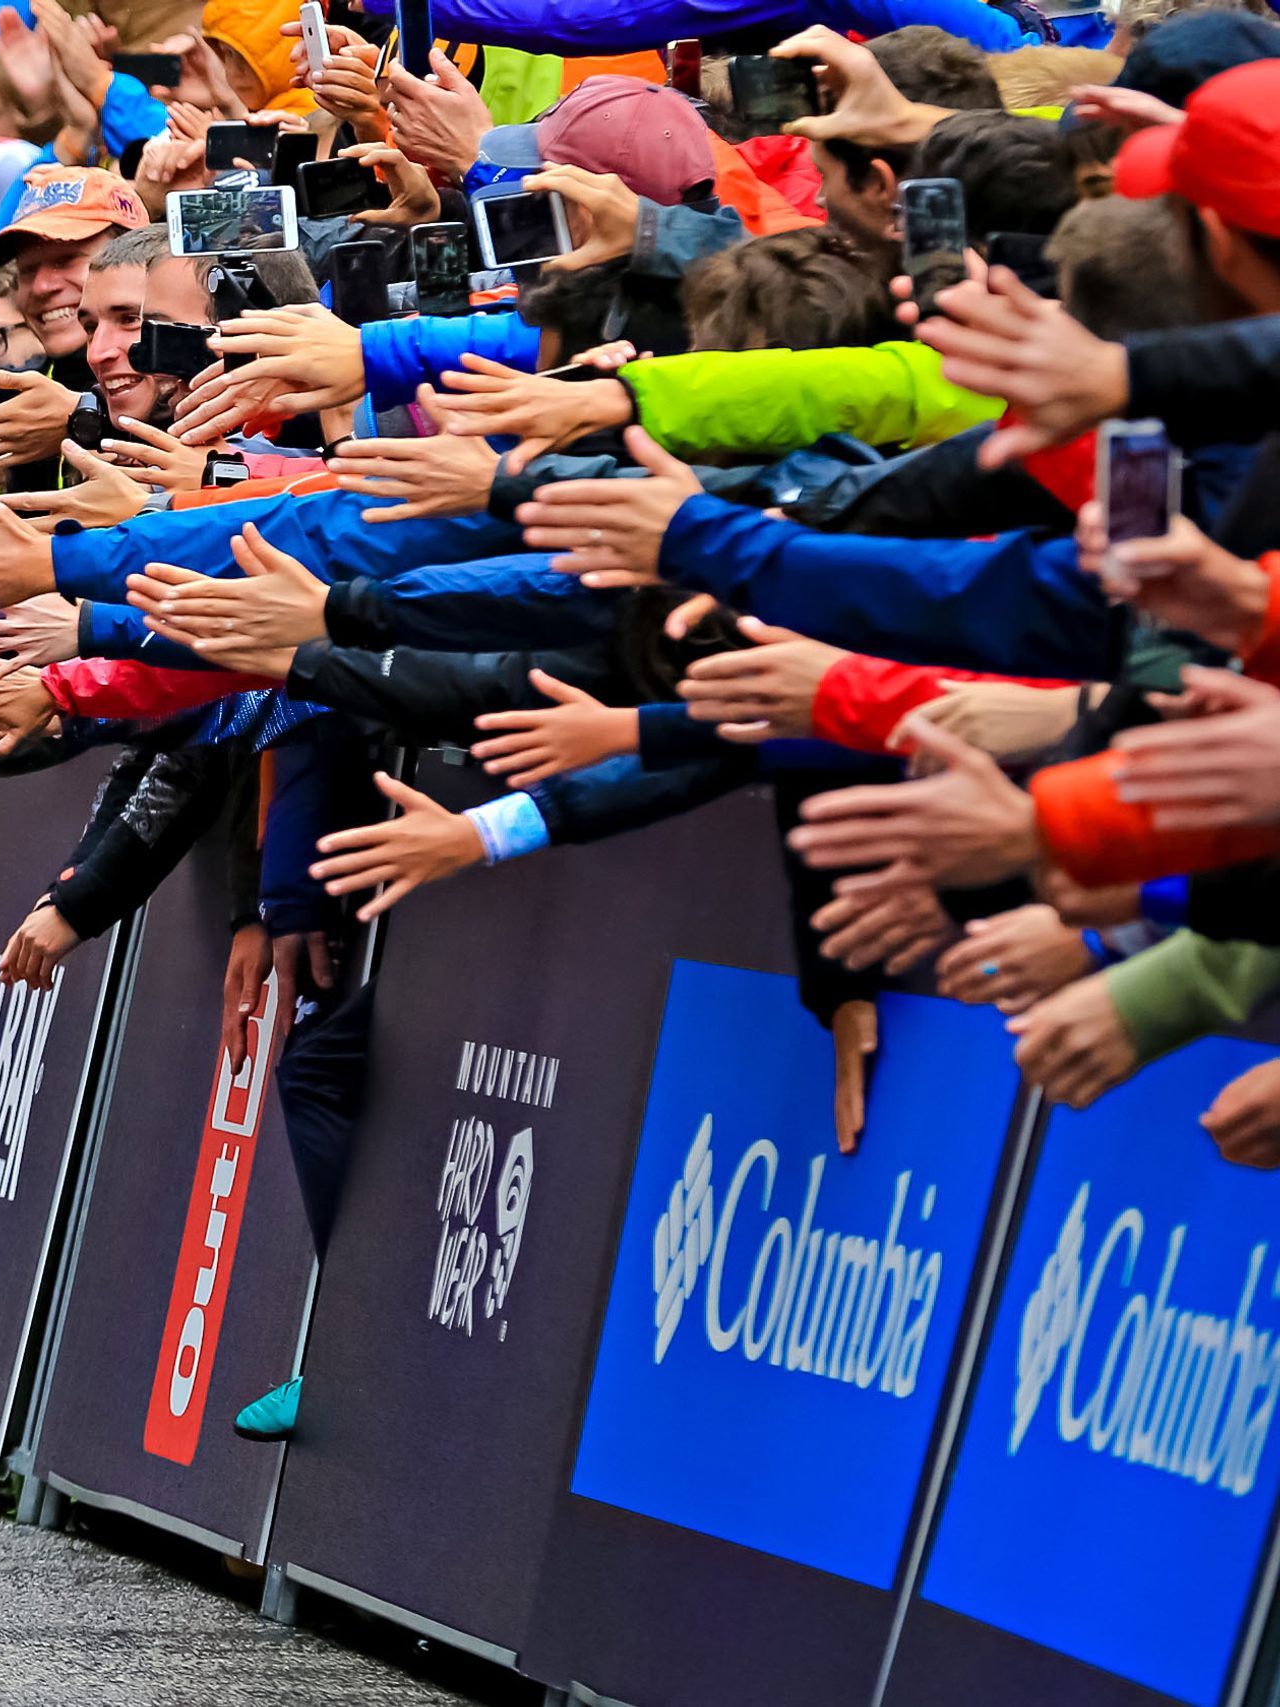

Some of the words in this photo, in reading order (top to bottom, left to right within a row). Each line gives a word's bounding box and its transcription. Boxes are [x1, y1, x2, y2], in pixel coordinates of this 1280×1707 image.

[456, 1041, 560, 1108] MOUNTAIN
[437, 1115, 495, 1227] HARD
[429, 1219, 488, 1338] WEAR
[706, 1139, 942, 1398] Columbia
